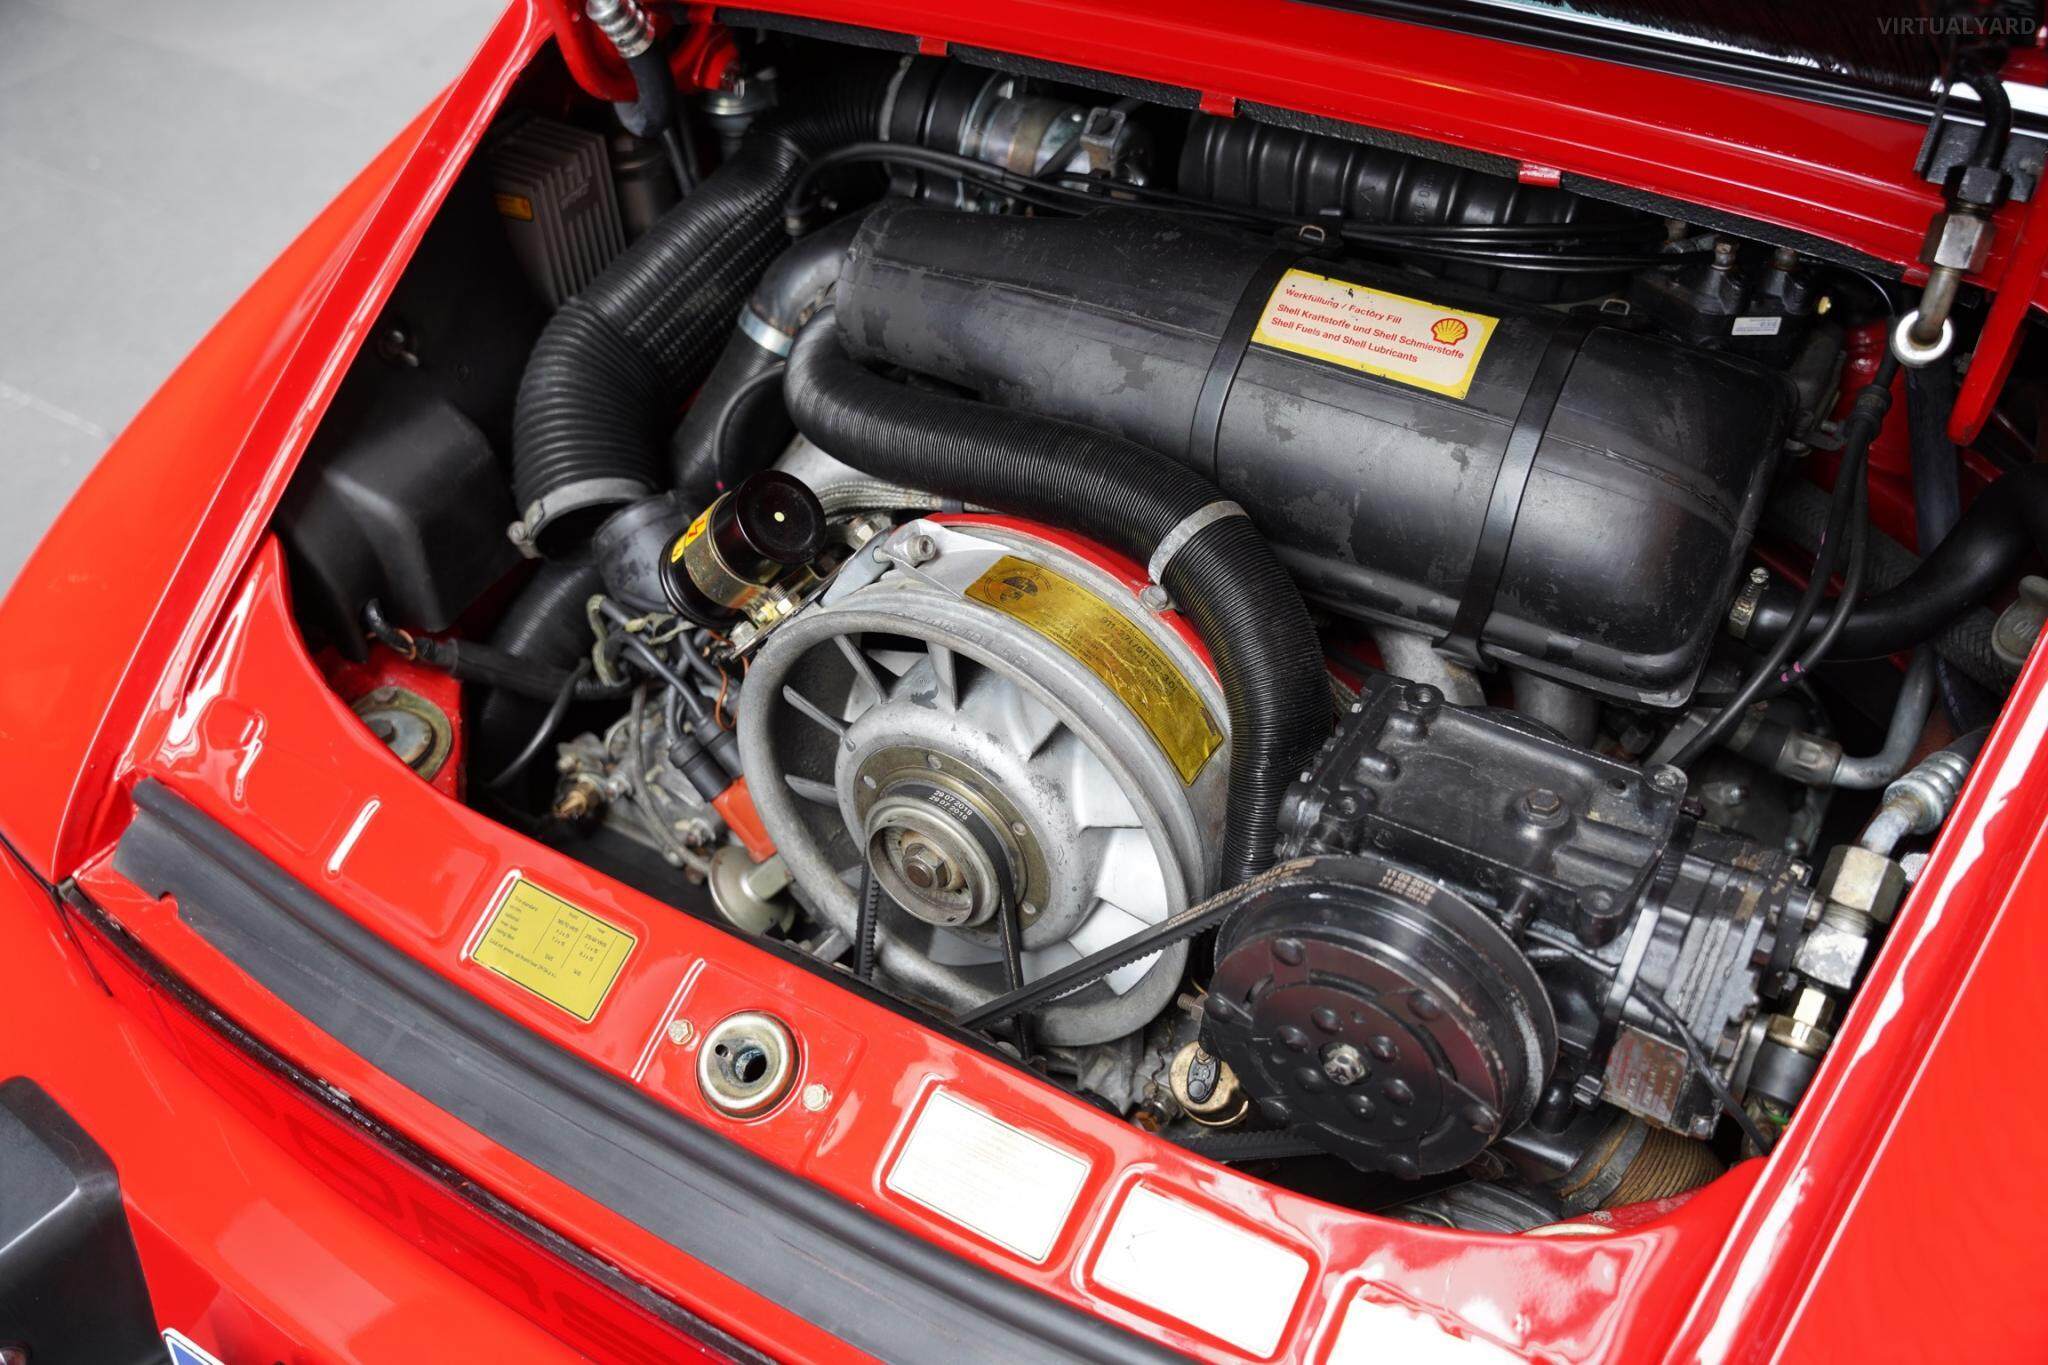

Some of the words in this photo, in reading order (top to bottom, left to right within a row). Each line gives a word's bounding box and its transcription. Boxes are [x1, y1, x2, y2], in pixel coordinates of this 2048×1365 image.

[1277, 303, 1300, 318] Shell
[1301, 309, 1351, 330] Kraftstoffe
[1353, 323, 1371, 334] und
[1373, 328, 1397, 343] Shell
[1399, 335, 1464, 360] Schmierstoffe
[1348, 304, 1385, 321] Factory
[1387, 313, 1402, 325] Fill
[1271, 317, 1294, 329] Shell
[1295, 322, 1321, 337] Fuels
[1322, 330, 1341, 342] and
[1342, 335, 1367, 349] Shell
[1368, 341, 1418, 363] Lubricants
